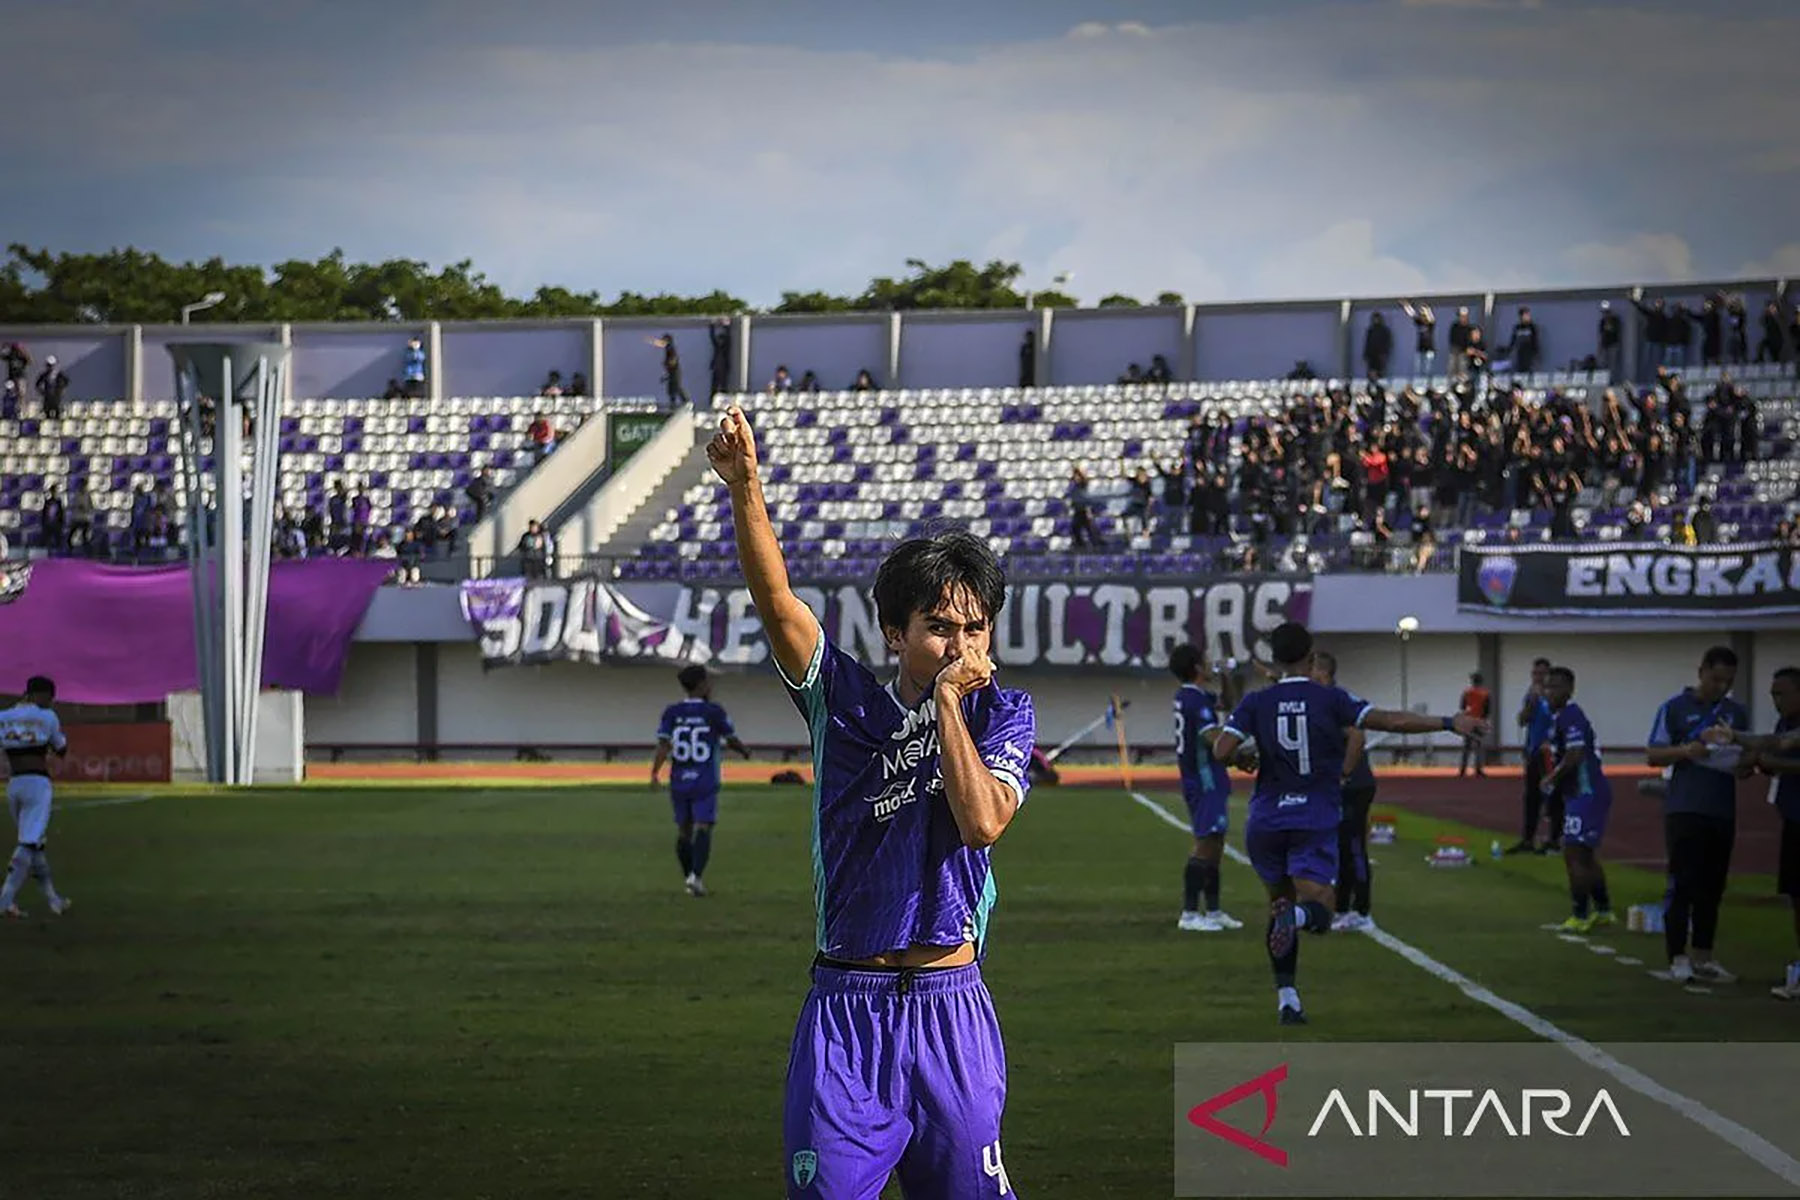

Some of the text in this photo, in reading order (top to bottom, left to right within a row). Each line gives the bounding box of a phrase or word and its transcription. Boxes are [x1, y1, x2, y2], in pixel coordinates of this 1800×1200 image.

[1565, 552, 1800, 596] ENGKA
[996, 582, 1291, 668] ULTRAS
[672, 726, 711, 762] 66
[1276, 714, 1311, 776] 4
